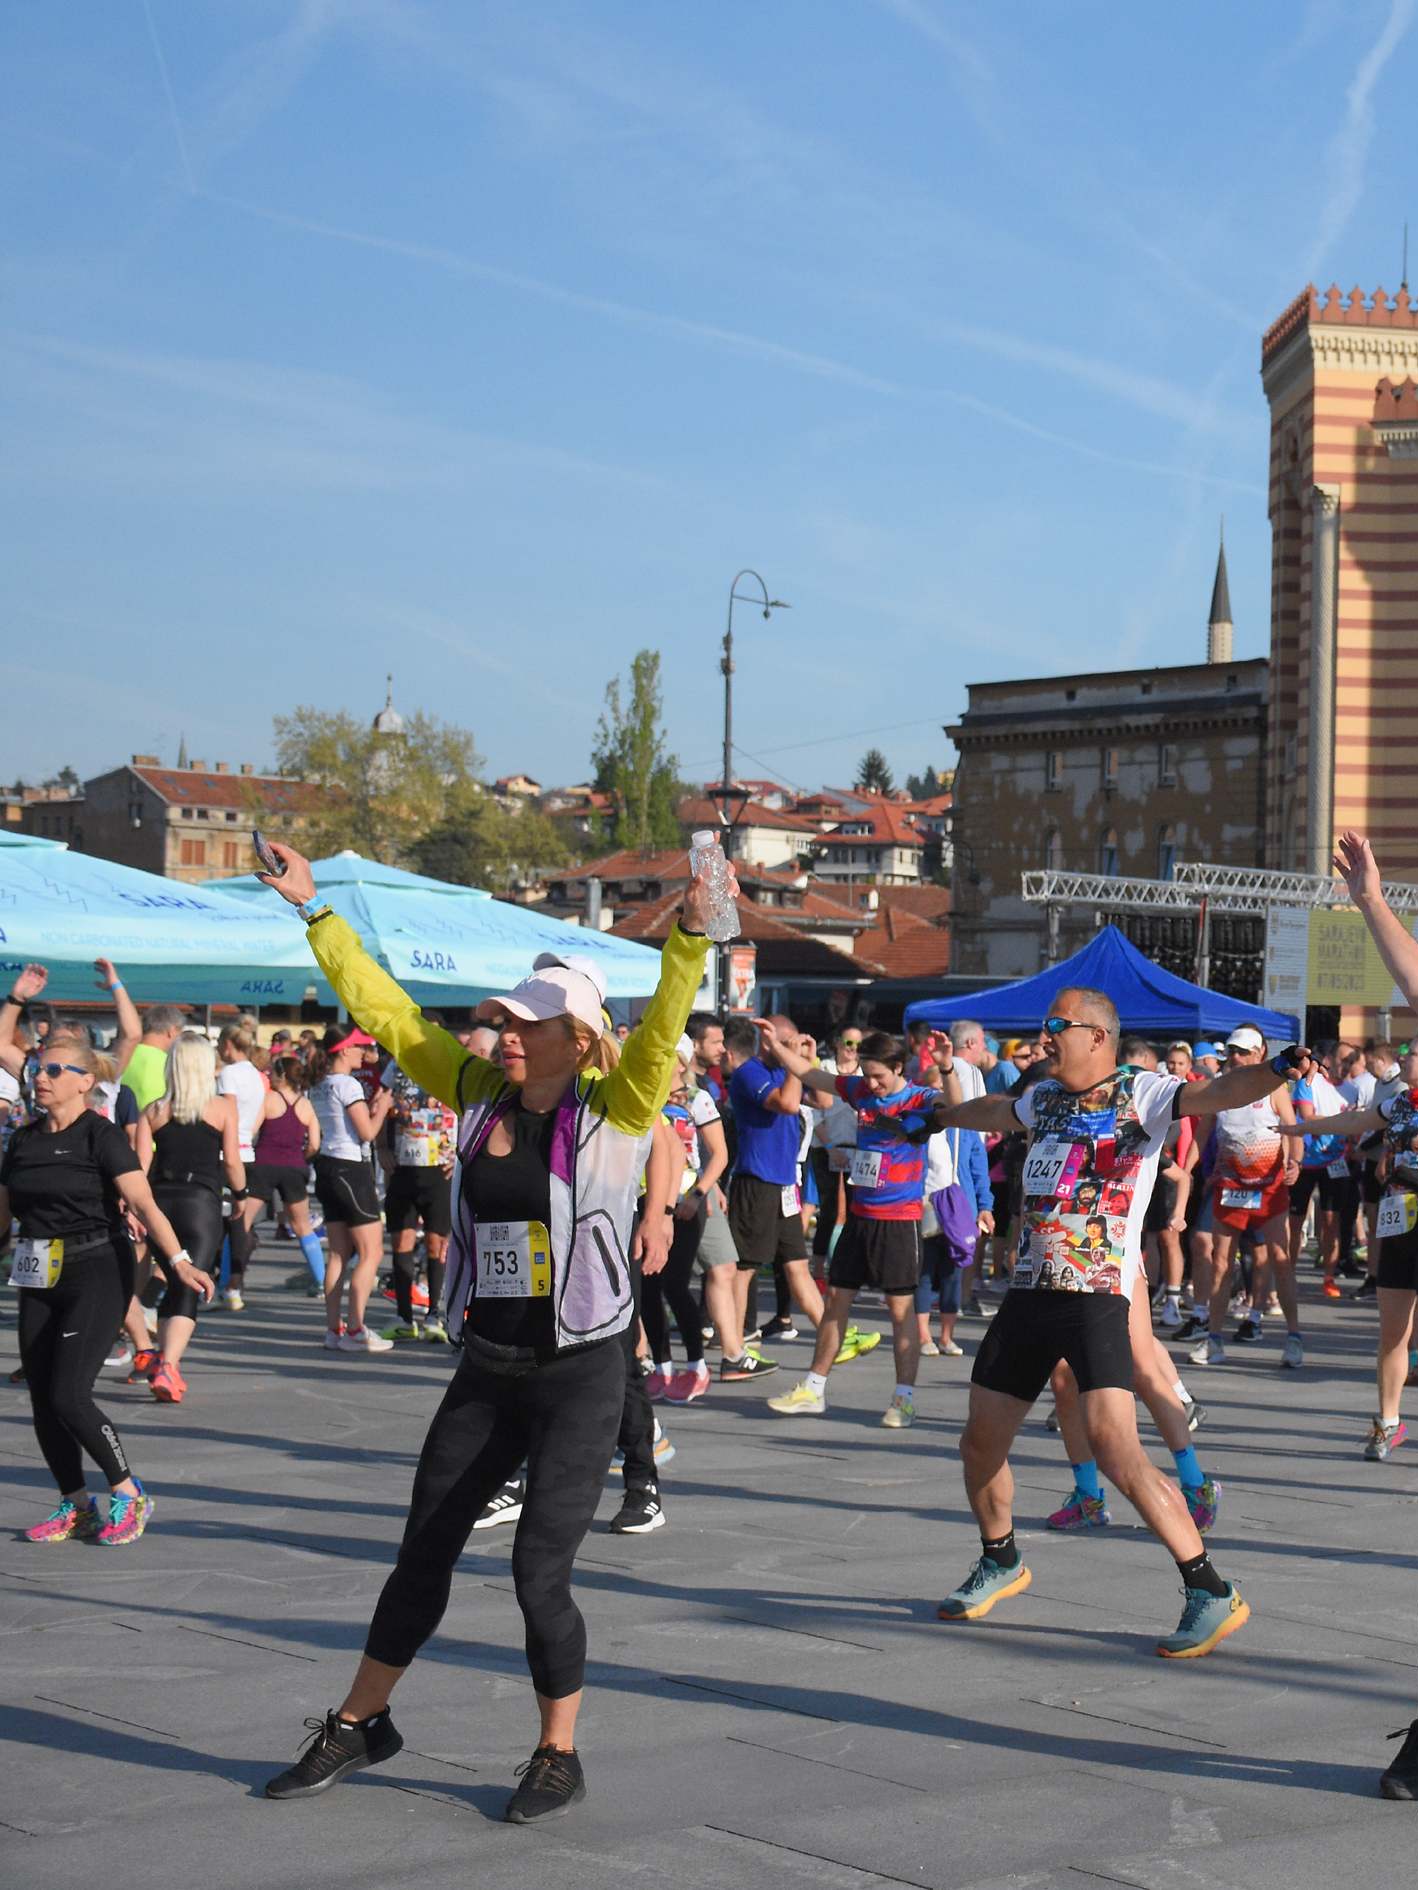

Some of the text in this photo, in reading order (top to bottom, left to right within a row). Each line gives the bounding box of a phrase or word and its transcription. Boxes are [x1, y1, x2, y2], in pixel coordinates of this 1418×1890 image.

[41, 931, 275, 952] NON CARBONATED NATURAL MINERAL WATER
[410, 949, 457, 972] SARA
[855, 1162, 877, 1177] 1474
[1026, 1160, 1063, 1179] 1247
[1057, 1183, 1071, 1195] 21
[1380, 1210, 1401, 1225] 832
[17, 1256, 40, 1273] 602
[483, 1250, 519, 1276] 753
[538, 1279, 545, 1291] 5
